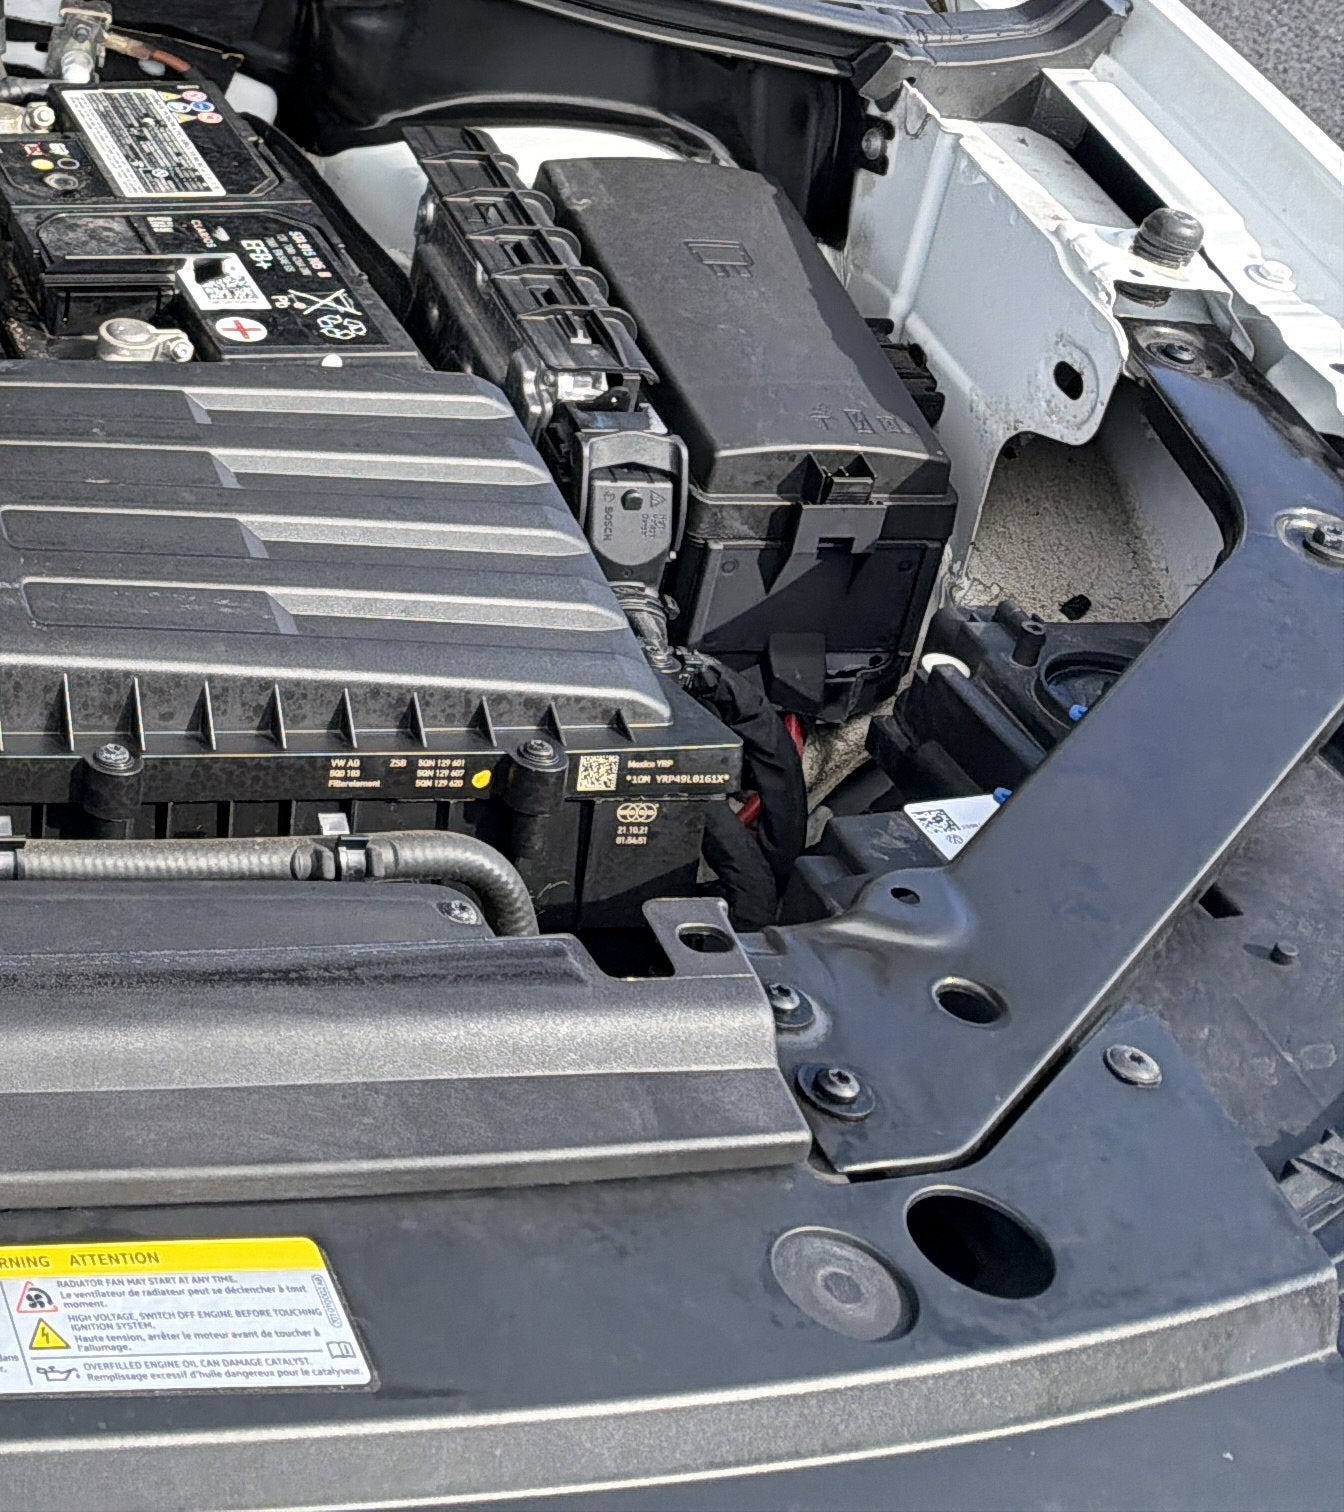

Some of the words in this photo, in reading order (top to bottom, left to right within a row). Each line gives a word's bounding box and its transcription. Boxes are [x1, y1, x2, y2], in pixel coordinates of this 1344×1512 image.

[272, 296, 290, 308] Pb
[603, 507, 613, 541] BOSCH
[331, 759, 346, 767] VW
[70, 1252, 160, 1267] ATTENTION
[57, 1279, 103, 1288] RADIATOR
[105, 1279, 124, 1287] FAN
[127, 1278, 146, 1286] MAY
[148, 1277, 176, 1286] START
[192, 1276, 210, 1284] ANY
[212, 1275, 238, 1283] TIME.
[73, 1290, 126, 1298] ventilateur
[142, 1288, 185, 1296] radiateur
[187, 1288, 210, 1297] peut
[225, 1285, 276, 1294] déclencher
[286, 1285, 307, 1293] tout
[63, 1301, 108, 1309] moment.
[68, 1314, 92, 1322] HIGH
[140, 1312, 175, 1320] SWITCH
[177, 1311, 195, 1320] OFF
[198, 1310, 233, 1319] ENGINE
[235, 1309, 271, 1318] BEFORE
[273, 1308, 322, 1317] TOUCHING
[71, 1323, 113, 1331] IGNITION
[115, 1322, 155, 1330] SYSTEM.
[74, 1335, 104, 1343] Haute
[194, 1331, 229, 1340] moteur
[231, 1331, 259, 1339] avant
[275, 1329, 312, 1338] toucher
[83, 1362, 142, 1371] OVERFILLED
[144, 1360, 181, 1369] ENGINE
[200, 1359, 220, 1367] CAN
[222, 1358, 263, 1367] DAMAGE
[87, 1372, 148, 1382] Remplissage
[150, 1371, 187, 1380] excessif
[224, 1368, 275, 1379] dangereux
[277, 1369, 298, 1378] pour
